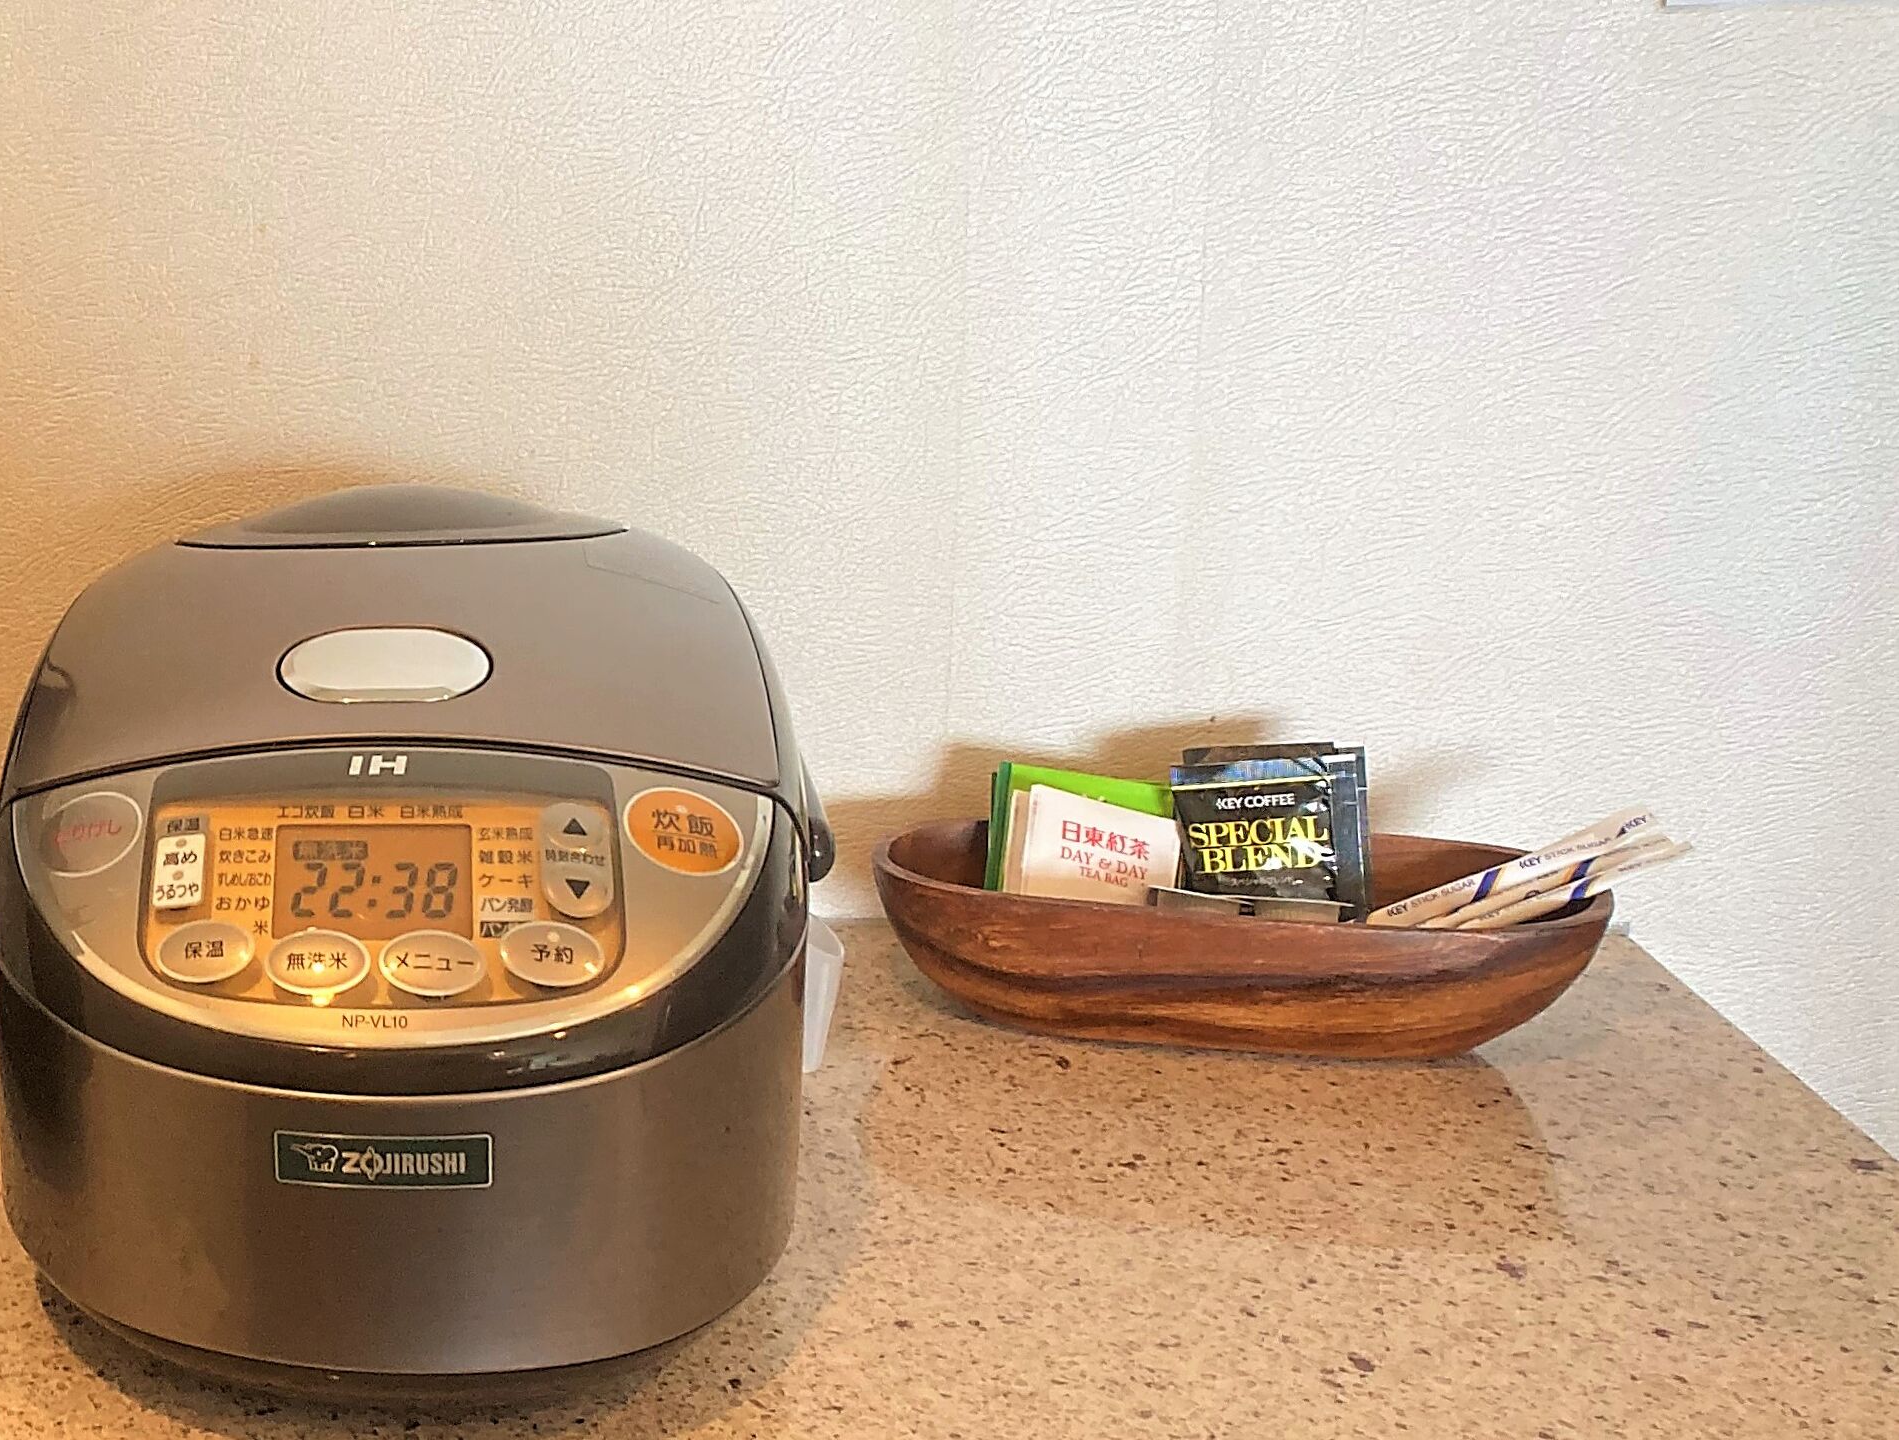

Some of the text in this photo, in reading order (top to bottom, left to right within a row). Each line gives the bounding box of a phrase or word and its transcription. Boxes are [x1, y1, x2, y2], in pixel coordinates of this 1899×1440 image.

[348, 755, 408, 776] IH
[1216, 792, 1296, 810] KEY COFFEE
[348, 805, 385, 819] 白米
[166, 816, 201, 833] 保温
[652, 808, 716, 838] 炊飯
[1188, 815, 1329, 849] SPECIAL
[219, 827, 276, 841] 白米急速
[1062, 820, 1150, 861] 日東紅茶
[163, 851, 198, 866] 高め
[218, 849, 271, 864] 炊きこみ
[1060, 846, 1148, 881] DAY & DAY
[1196, 842, 1326, 874] BLEND
[1519, 855, 1543, 871] KEY
[478, 873, 534, 889] ケーキ
[1079, 866, 1128, 888] TEA BAG
[155, 881, 200, 901] うるつや
[290, 861, 459, 919] 22:38
[215, 896, 271, 912] おかゆ
[1386, 902, 1409, 918] KEY
[183, 940, 225, 960] 保温
[530, 943, 575, 965] 予約
[285, 951, 349, 972] 無洗米
[395, 952, 475, 972] メニュー
[342, 1014, 409, 1030] NP-VL10
[341, 1145, 467, 1181] ZOJIRUSHI
